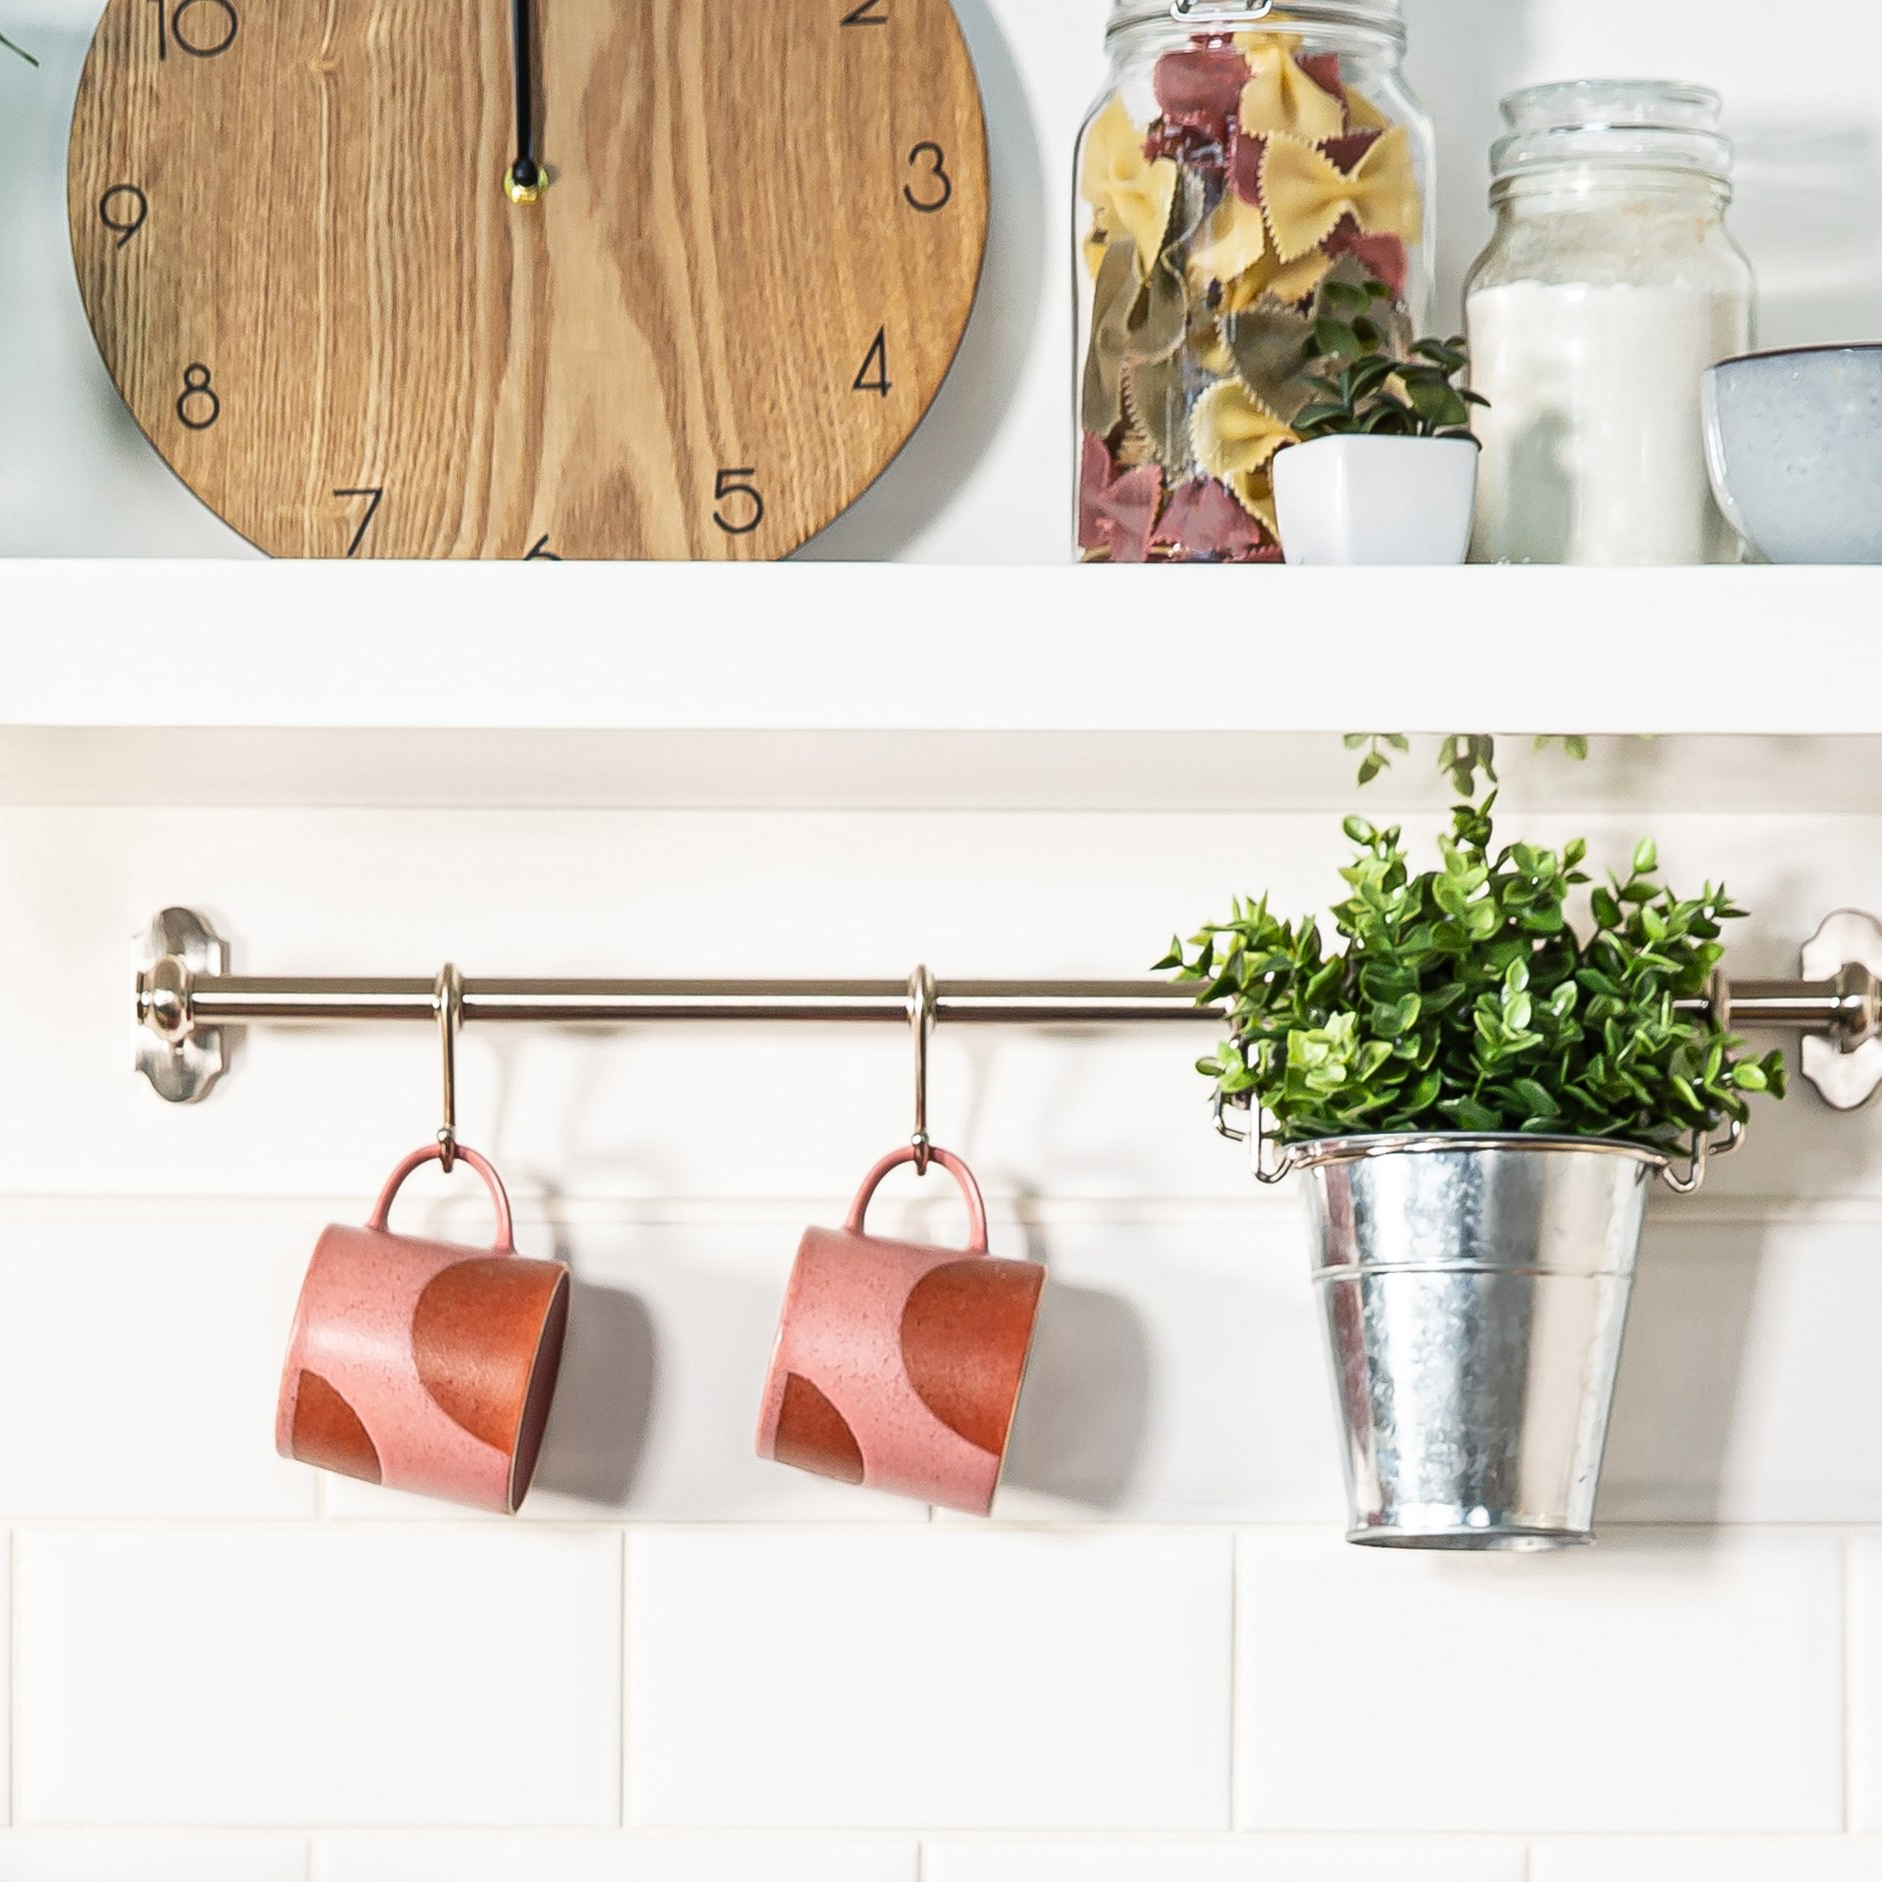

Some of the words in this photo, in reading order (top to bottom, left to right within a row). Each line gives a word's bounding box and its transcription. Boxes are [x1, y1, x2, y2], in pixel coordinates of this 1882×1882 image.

[147, 0, 238, 60] 10
[903, 142, 952, 212] 3
[99, 183, 148, 248] 9
[852, 325, 893, 398] 4
[176, 362, 220, 430] 8
[332, 487, 383, 557] 7
[712, 468, 764, 535] 5
